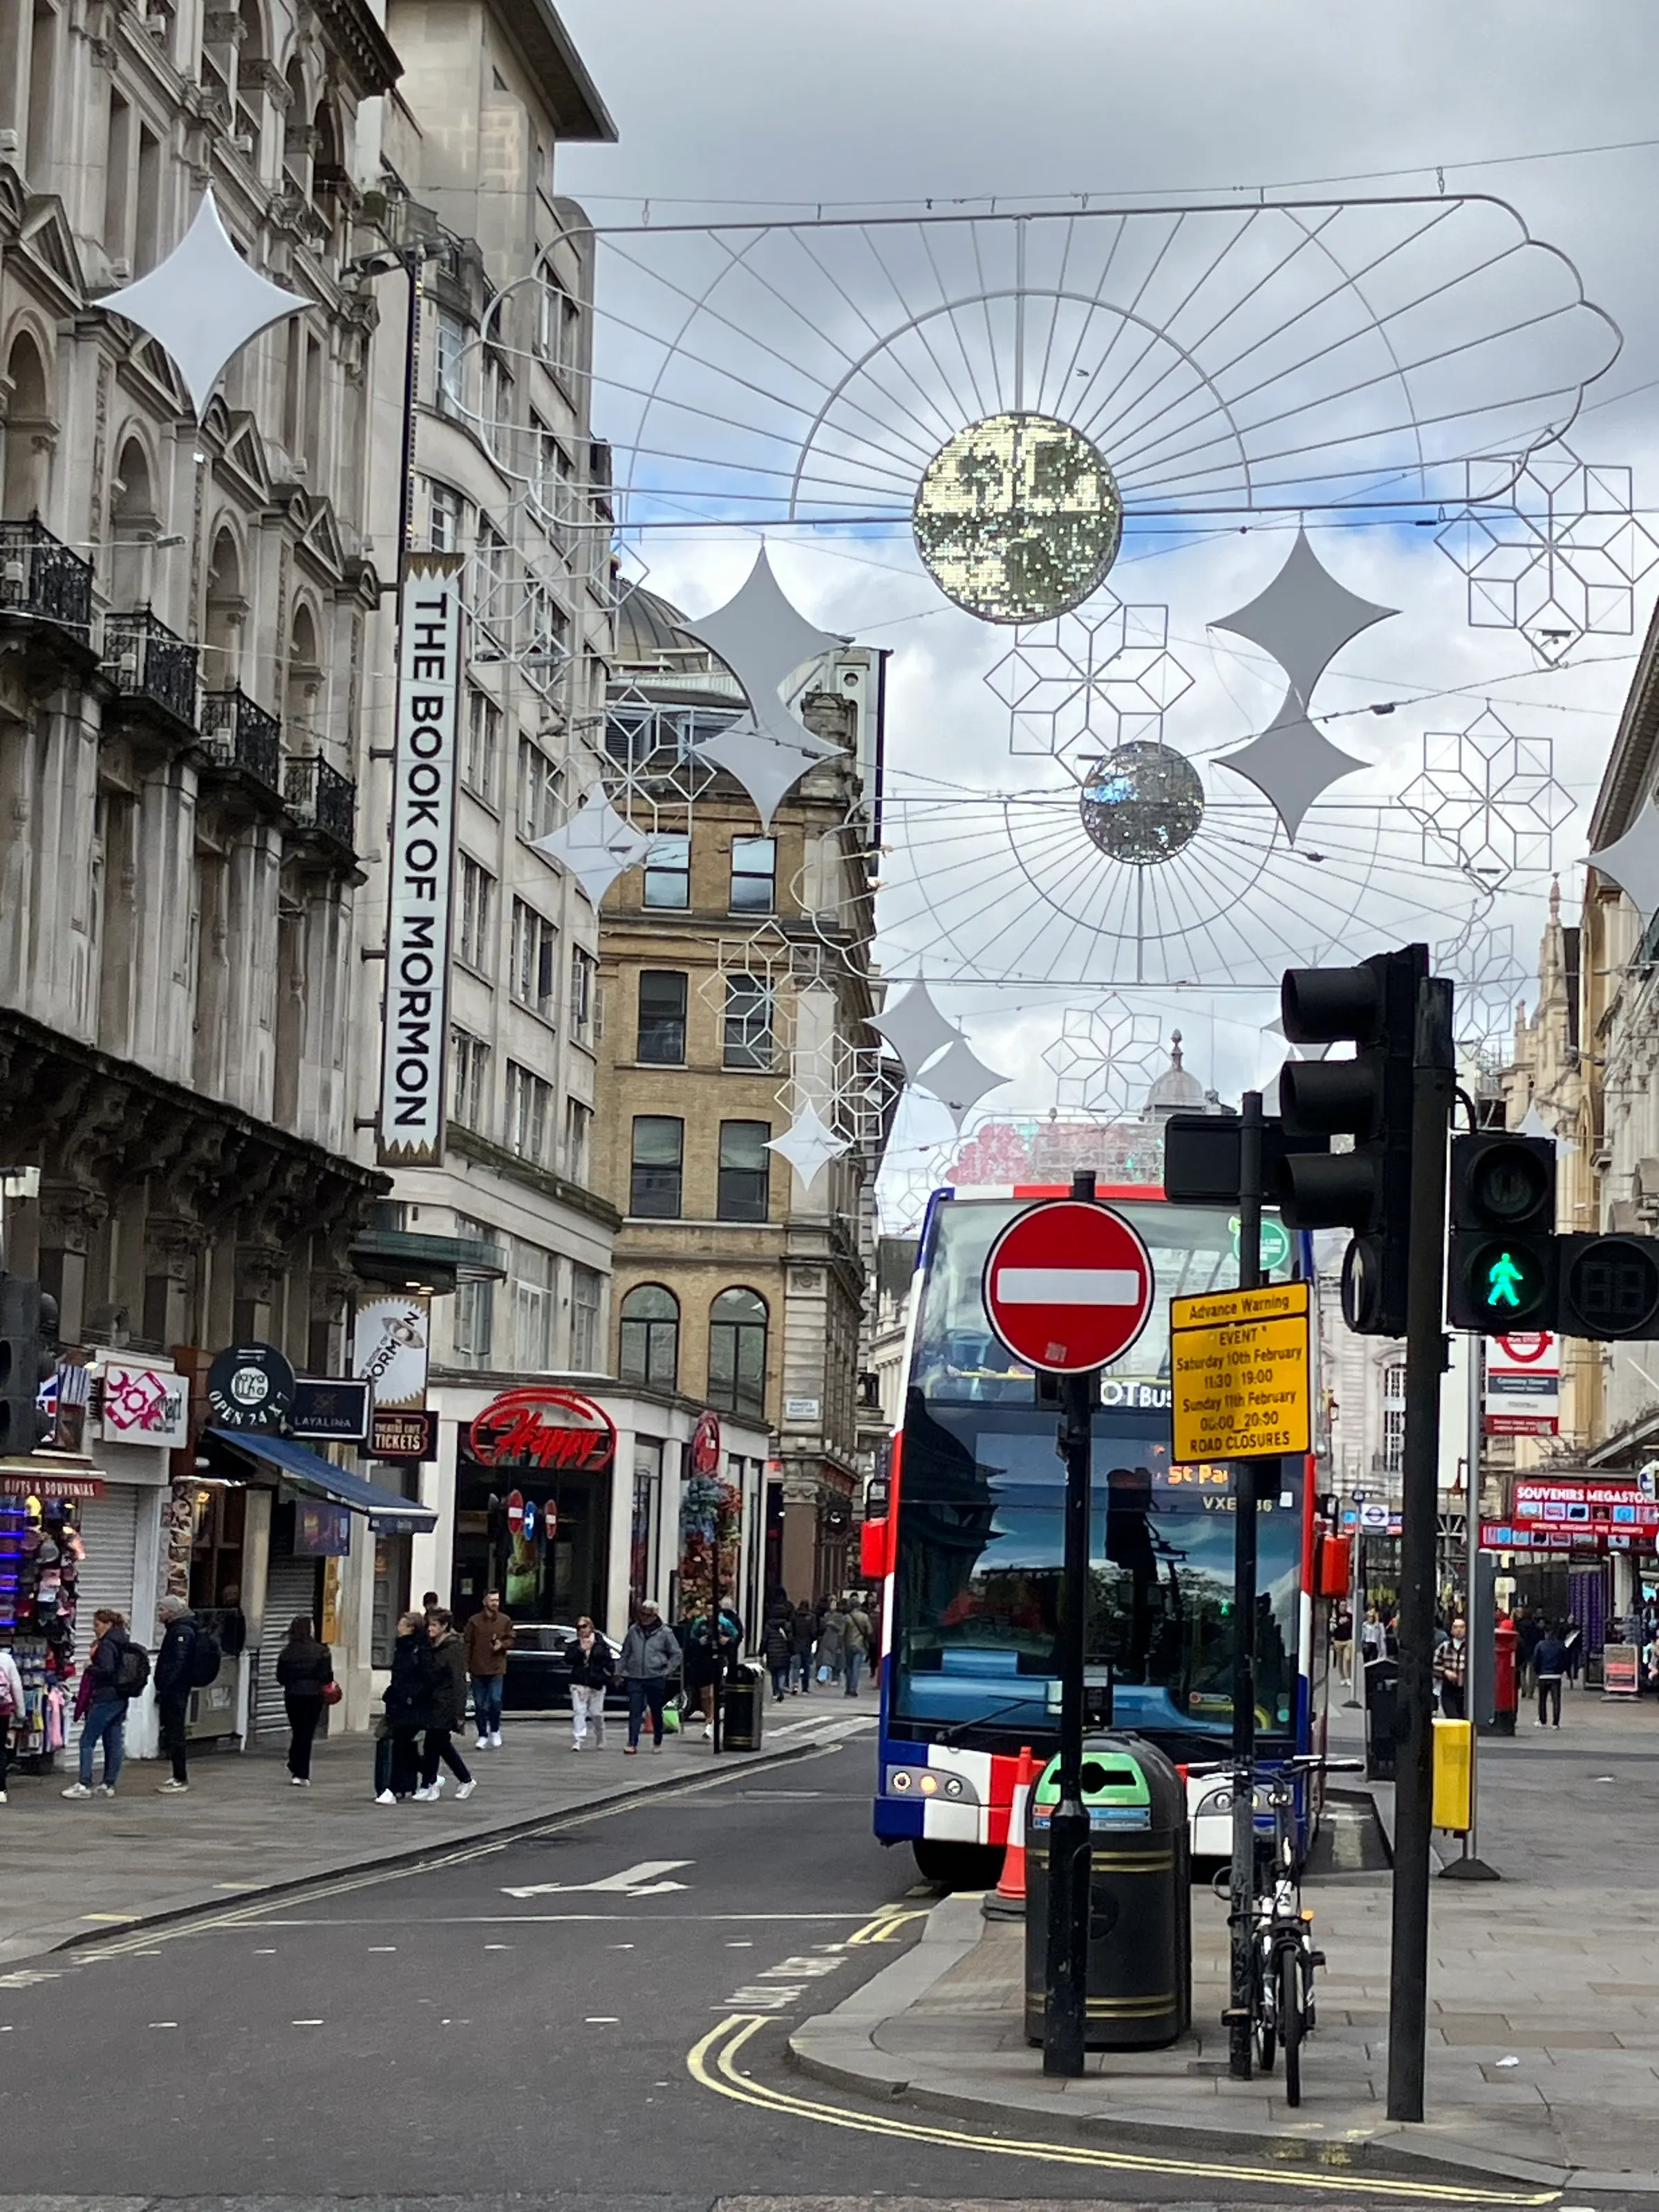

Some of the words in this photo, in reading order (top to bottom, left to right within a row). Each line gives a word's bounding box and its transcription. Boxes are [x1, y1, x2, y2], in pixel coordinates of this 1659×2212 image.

[413, 592, 447, 679] THE
[406, 695, 444, 830] BOOK
[404, 838, 438, 901] OF
[394, 916, 435, 1125] MORMON
[1188, 1300, 1237, 1320] Advance
[1241, 1295, 1290, 1313] Warning
[1219, 1327, 1257, 1346] EVENT
[1177, 1354, 1224, 1371] Saturday
[1227, 1350, 1250, 1366] 10th
[1254, 1347, 1302, 1363] February
[1241, 1368, 1273, 1385] 19:00
[209, 1390, 245, 1425] OPEN
[249, 1412, 268, 1425] 24
[1183, 1398, 1222, 1413] Sunday
[1224, 1391, 1244, 1408] 11th
[1248, 1390, 1297, 1406] February
[294, 1414, 352, 1428] LAYALINA
[375, 1434, 420, 1450] TICKETS
[489, 1406, 601, 1469] Happy
[1190, 1436, 1222, 1452] ROAD
[1226, 1431, 1290, 1450] CLOSURES
[1168, 1465, 1193, 1485] St
[4, 1479, 31, 1494] GIFTS
[45, 1482, 95, 1497] SOUVENIRS
[1517, 1487, 1585, 1501] SOUVENIRS
[1586, 1489, 1647, 1505] MEGASTO
[1202, 1497, 1237, 1511] VXE
